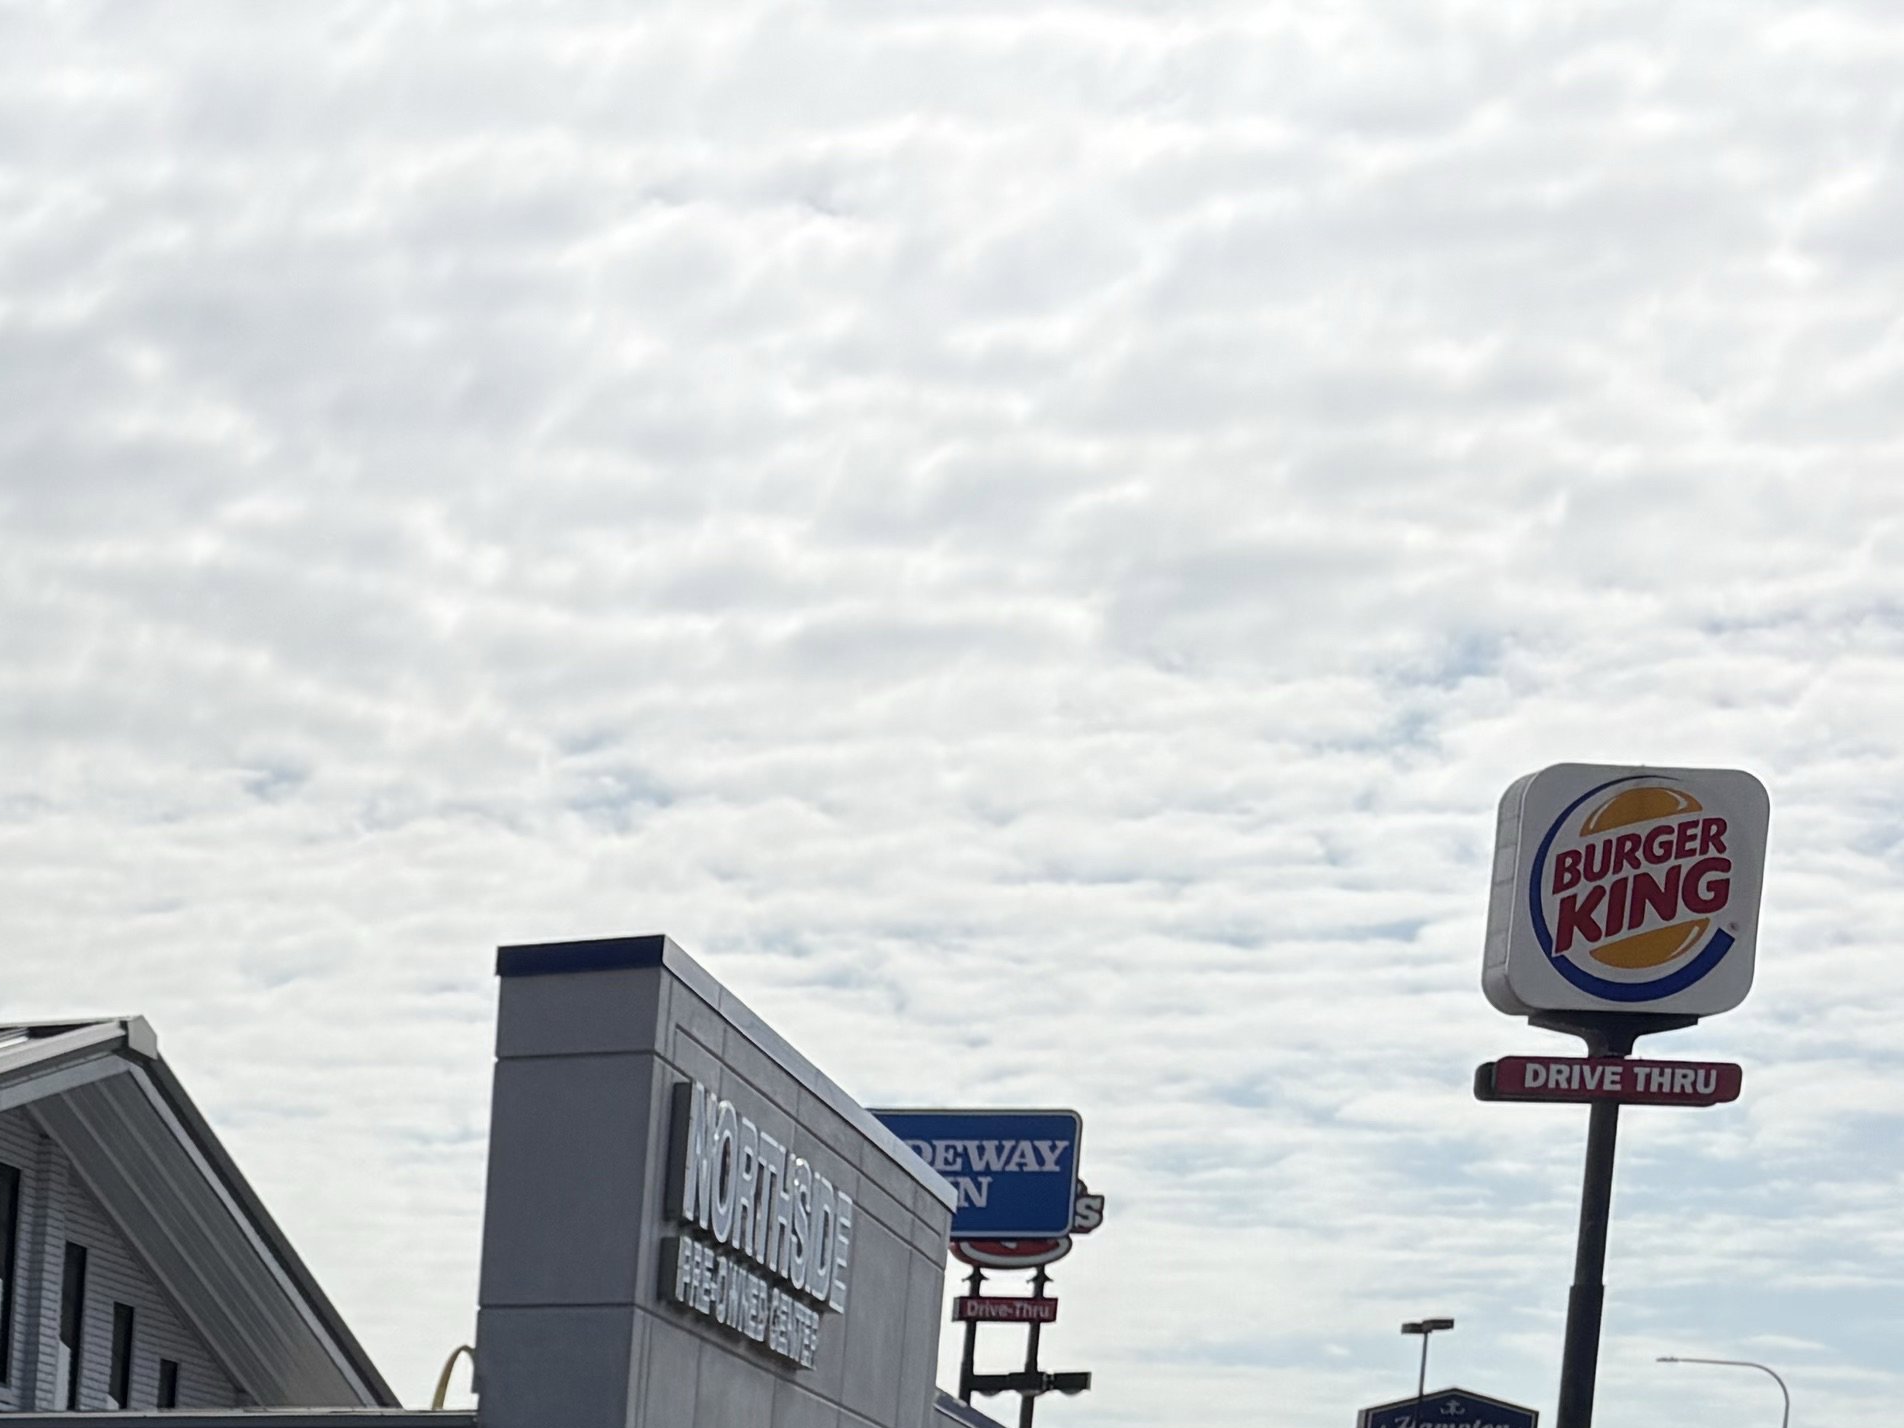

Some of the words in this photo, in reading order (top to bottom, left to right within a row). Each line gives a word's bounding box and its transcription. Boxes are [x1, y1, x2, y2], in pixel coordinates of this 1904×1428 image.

[1552, 817, 1727, 895] BURGER
[1552, 857, 1732, 955] KING
[1524, 1063, 1621, 1091] DRIVE
[1633, 1066, 1717, 1094] THRU
[903, 1139, 1069, 1172] DEWAY
[683, 1081, 853, 1314] NORTHSIDE
[966, 1301, 1050, 1318] Drive-Thru
